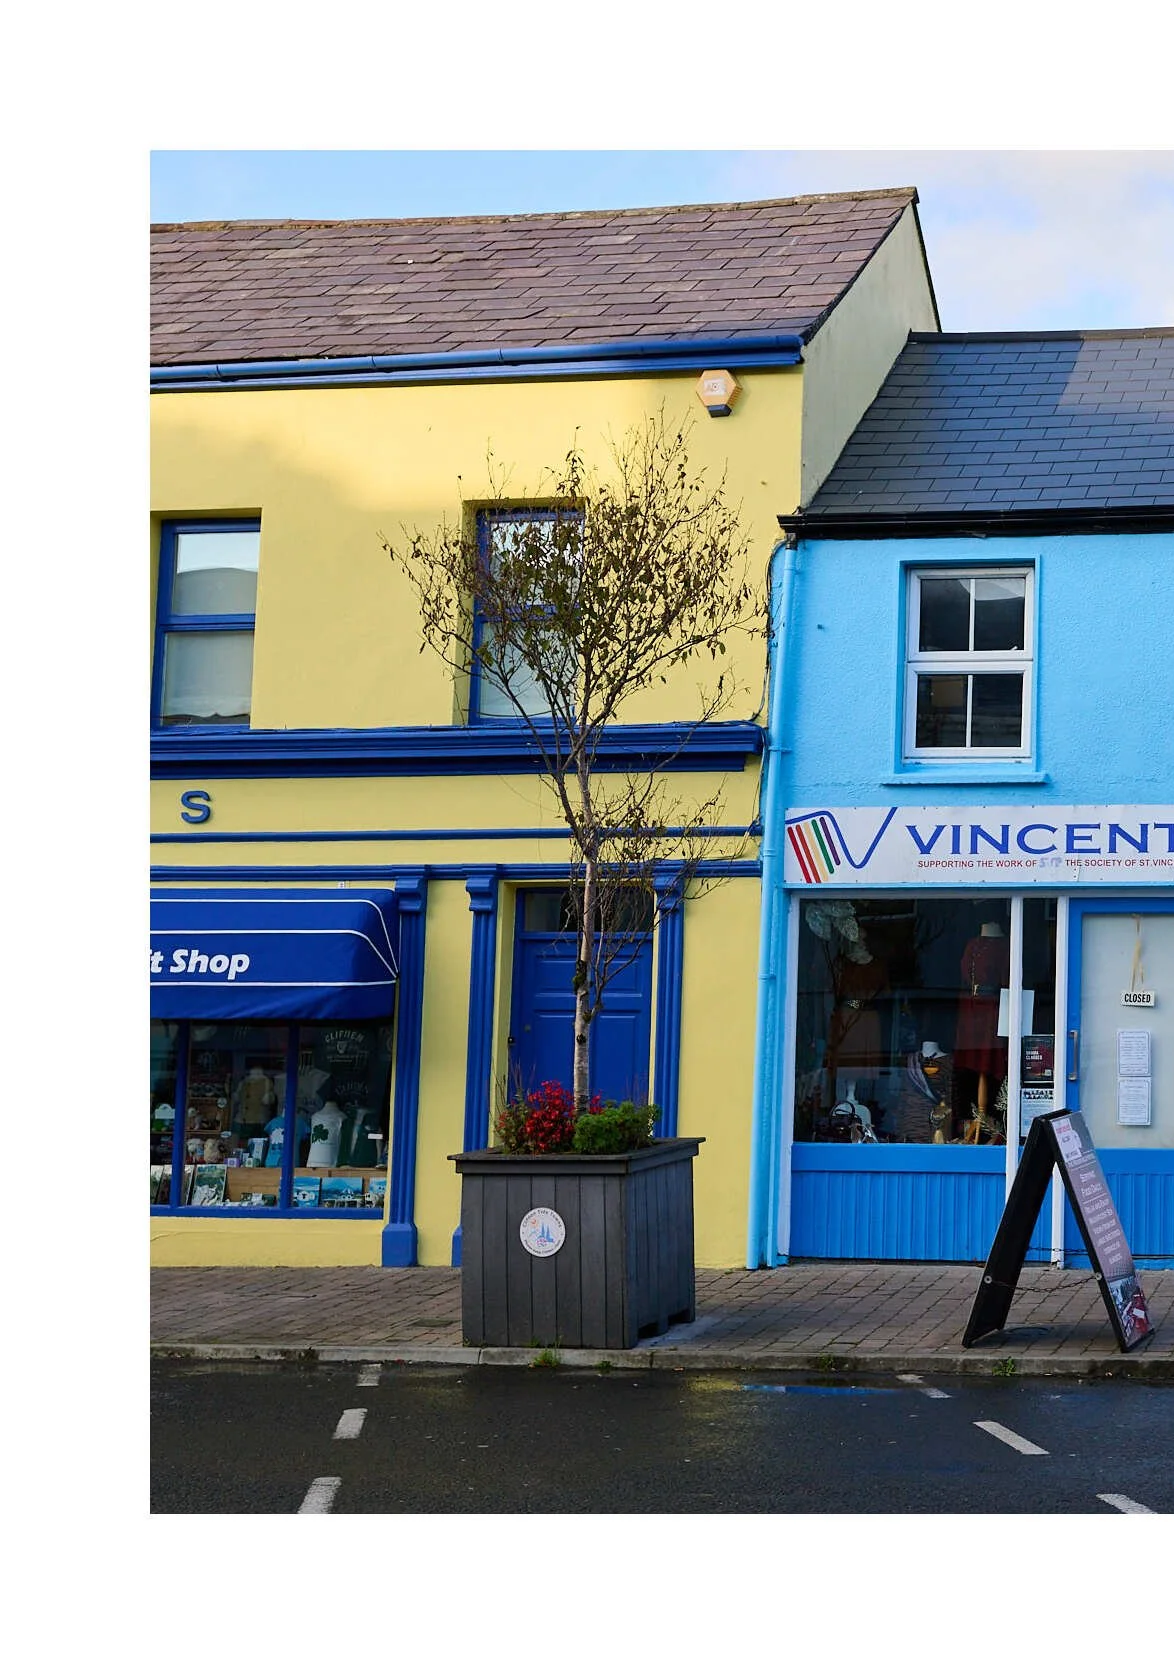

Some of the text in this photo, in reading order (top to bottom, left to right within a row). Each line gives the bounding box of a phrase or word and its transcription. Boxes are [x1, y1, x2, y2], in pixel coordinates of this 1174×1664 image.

[181, 790, 211, 824] S
[918, 859, 974, 869] SUPPORTING
[977, 859, 994, 868] THE
[996, 859, 1022, 868] WORK
[1025, 859, 1038, 868] OF
[1065, 858, 1083, 867] THE
[1084, 858, 1122, 867] SOCIETY
[1124, 858, 1137, 867] OF
[150, 948, 250, 981] t Shop
[1124, 992, 1151, 1004] CLOSED
